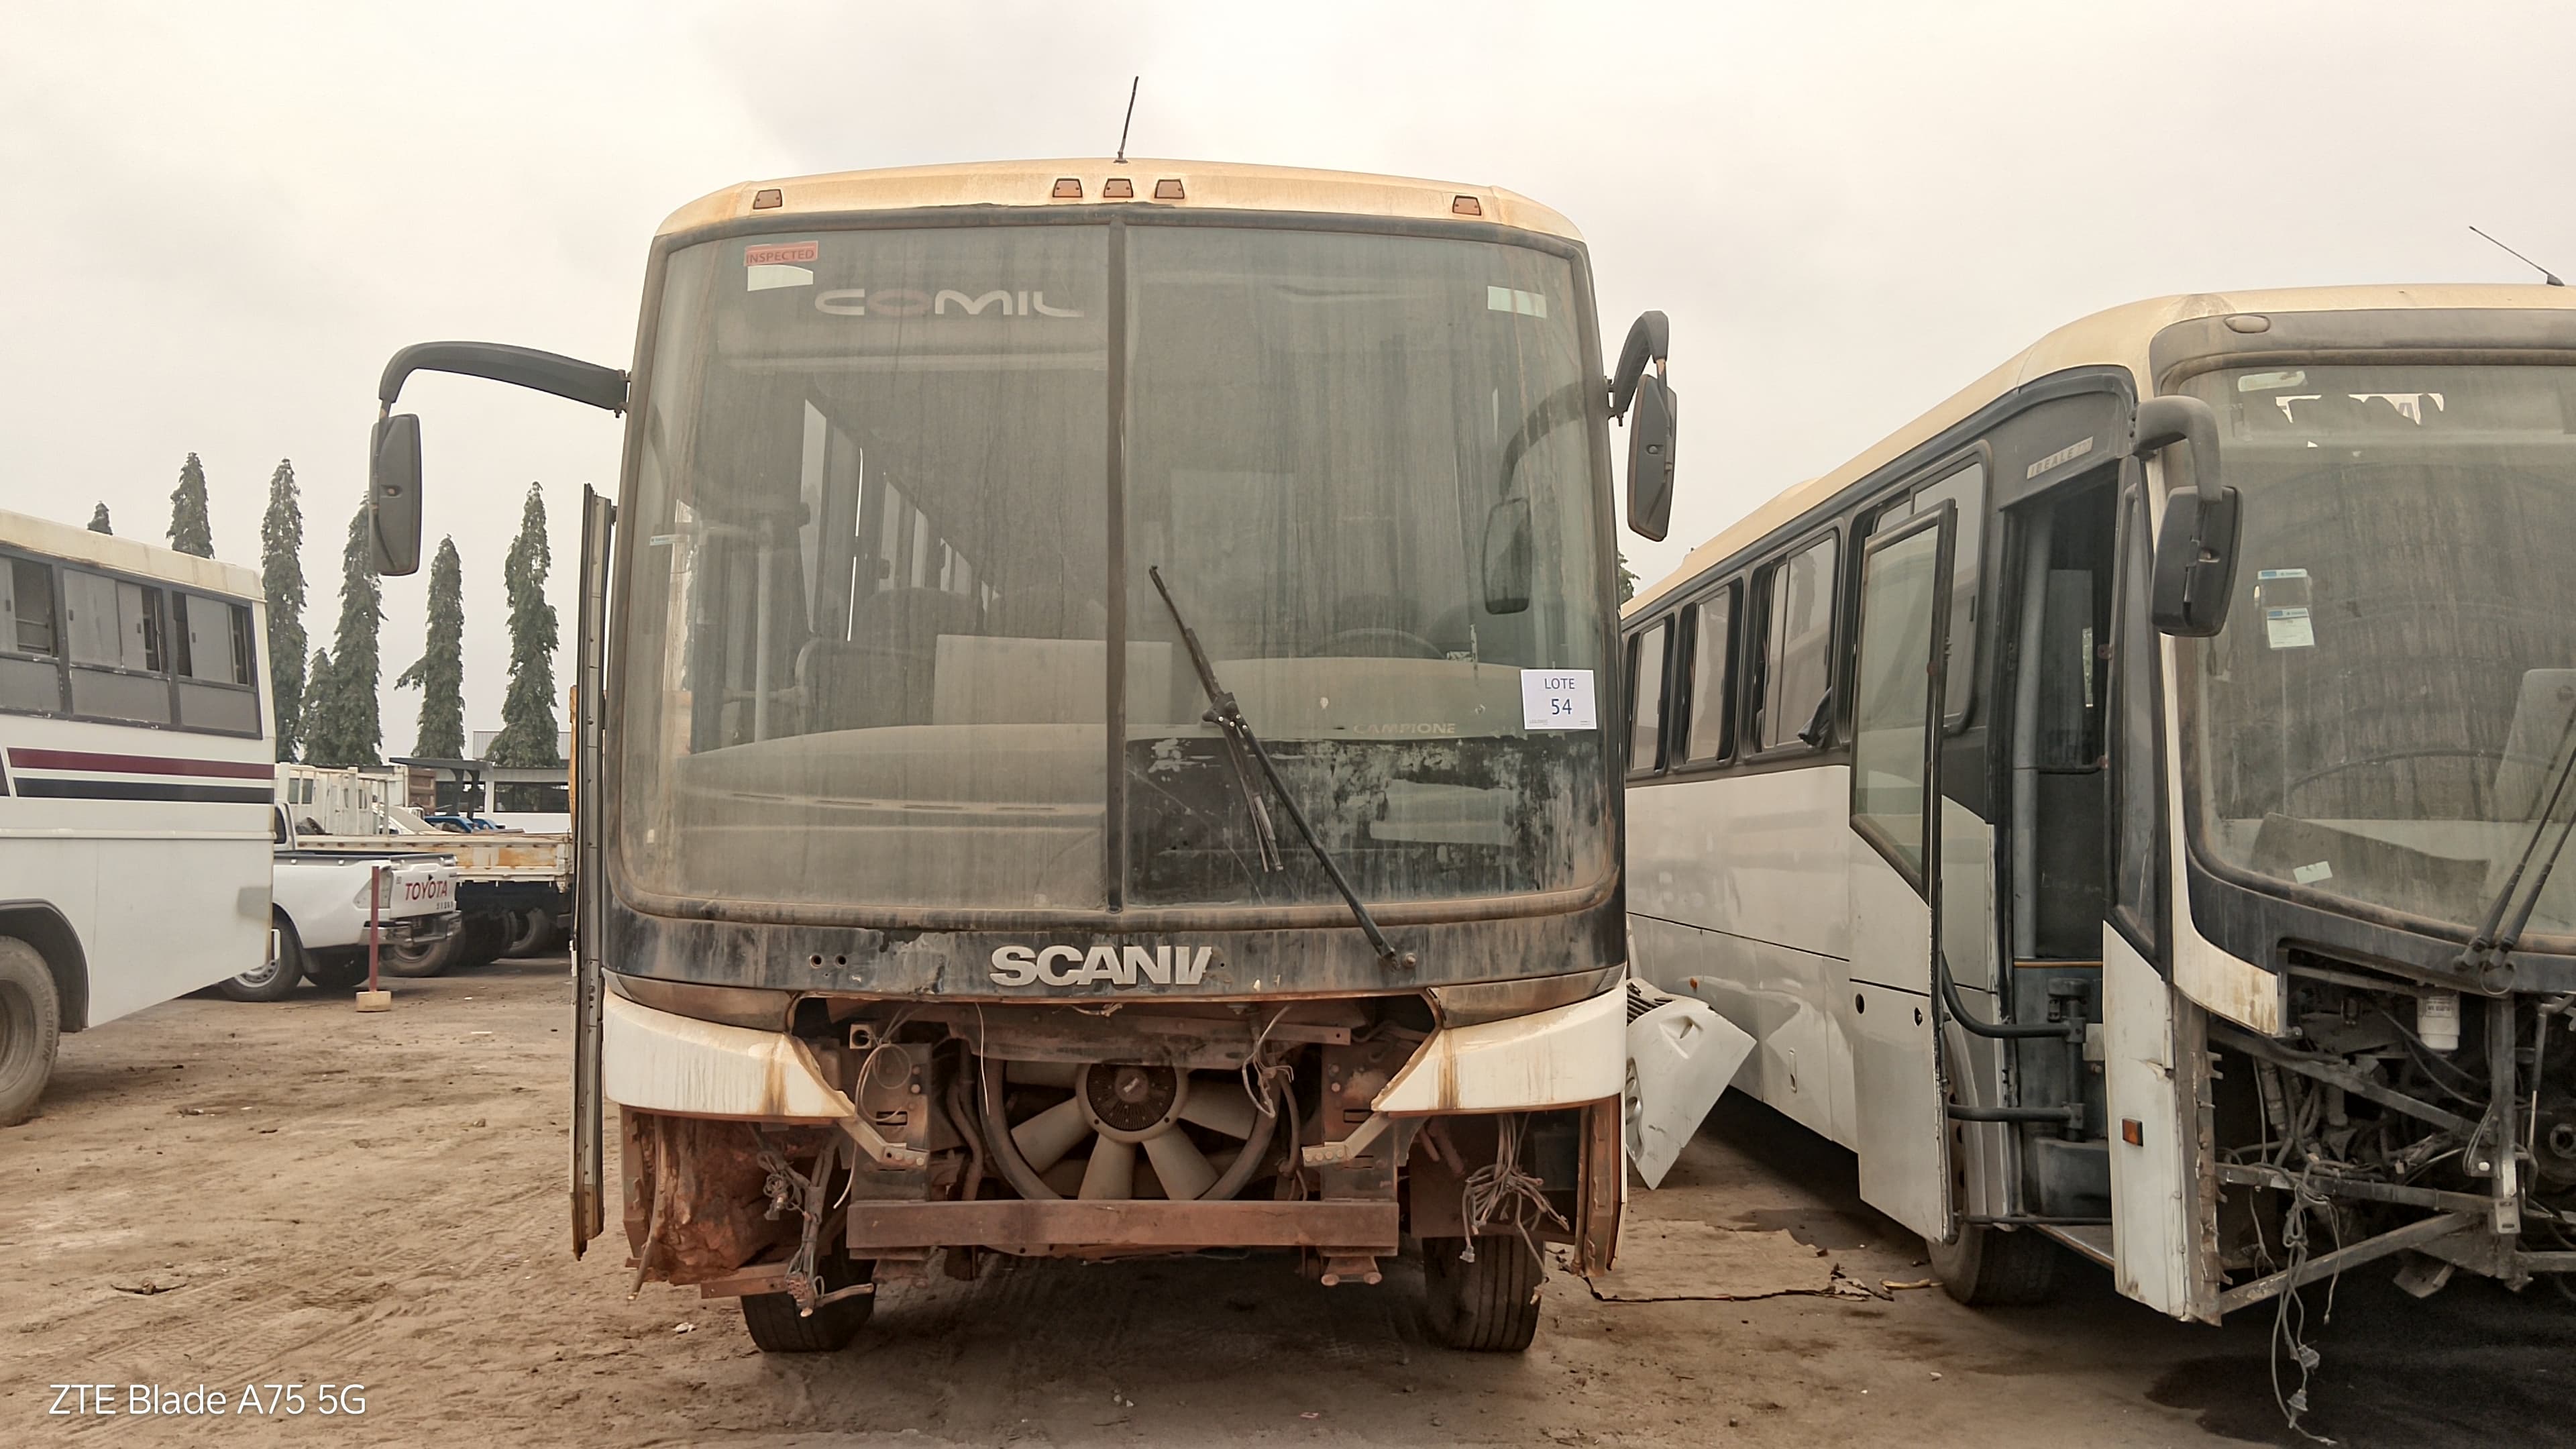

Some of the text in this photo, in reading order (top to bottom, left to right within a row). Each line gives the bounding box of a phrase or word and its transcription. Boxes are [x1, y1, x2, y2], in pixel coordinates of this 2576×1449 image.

[746, 250, 814, 264] INSPECTED
[814, 288, 1085, 317] COMIL
[1544, 678, 1575, 690] LOTE
[1551, 698, 1572, 715] 54
[1353, 722, 1455, 735] CAMPIONE
[405, 880, 448, 901] TOYOTA
